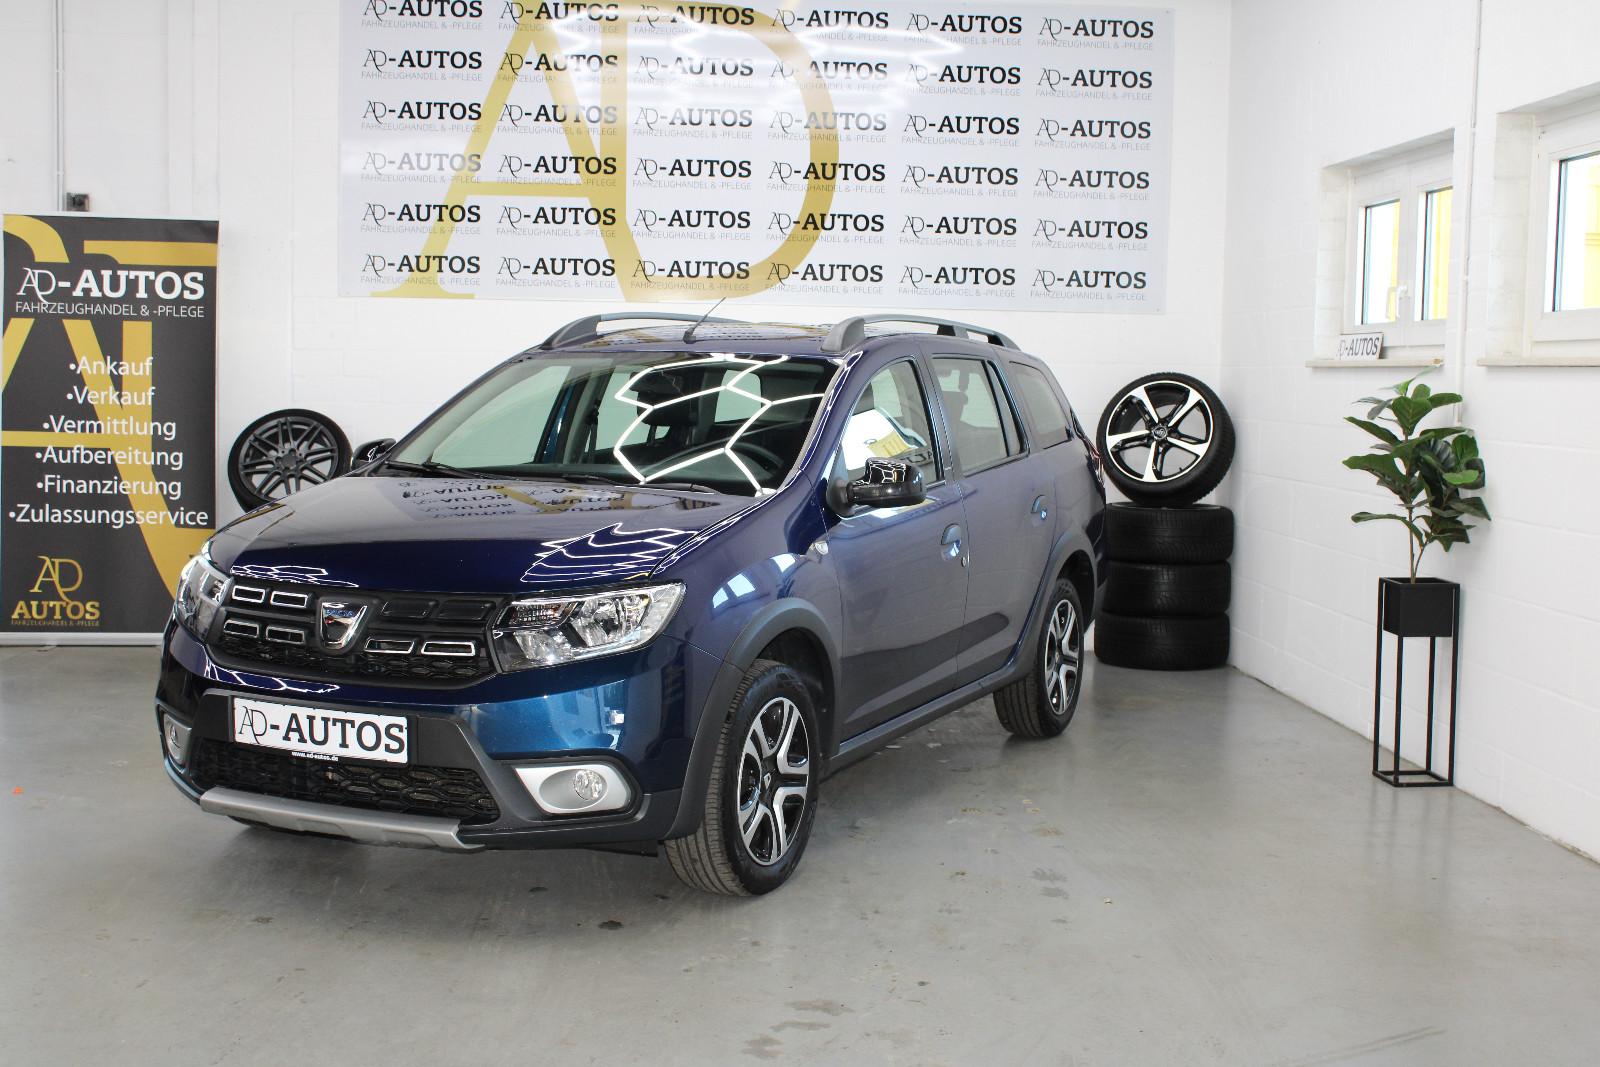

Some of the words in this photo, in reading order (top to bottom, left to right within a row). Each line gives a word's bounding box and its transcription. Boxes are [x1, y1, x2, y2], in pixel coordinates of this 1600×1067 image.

[364, 0, 483, 22] AD-AUTOS
[501, 1, 619, 26] AD-AUTOS
[772, 9, 889, 34] AD-AUTOS
[906, 13, 1023, 37] AD-AUTOS
[1040, 17, 1155, 41] AD-AUTOS
[363, 49, 482, 73] AD-AUTOS
[905, 64, 1021, 88] AD-AUTOS
[1038, 67, 1154, 92] AD-AUTOS
[363, 100, 481, 125] AD-AUTOS
[499, 104, 617, 128] AD-AUTOS
[635, 107, 752, 132] AD-AUTOS
[770, 111, 886, 135] AD-AUTOS
[904, 114, 1020, 139] AD-AUTOS
[1037, 118, 1152, 142] AD-AUTOS
[362, 151, 481, 176] AD-AUTOS
[499, 155, 617, 179] AD-AUTOS
[634, 158, 751, 182] AD-AUTOS
[769, 162, 885, 186] AD-AUTOS
[902, 165, 1018, 189] AD-AUTOS
[1035, 168, 1150, 192] AD-AUTOS
[362, 203, 480, 227] AD-AUTOS
[498, 206, 616, 230] AD-AUTOS
[633, 209, 750, 233] AD-AUTOS
[768, 212, 884, 236] AD-AUTOS
[901, 215, 1017, 239] AD-AUTOS
[1034, 219, 1148, 242] AD-AUTOS
[362, 253, 480, 277] AD-AUTOS
[498, 257, 615, 280] AD-AUTOS
[633, 260, 749, 283] AD-AUTOS
[767, 263, 883, 286] AD-AUTOS
[16, 267, 205, 304] AD-AUTOS
[900, 266, 1015, 289] AD-AUTOS
[1032, 269, 1147, 292] AD-AUTOS
[15, 302, 137, 316] FAHRZEUGHANDEL
[140, 305, 150, 316] &
[153, 306, 205, 318] -PFLEGE
[11, 600, 100, 620] AUTOS
[238, 705, 405, 754] AD-AUTOS
